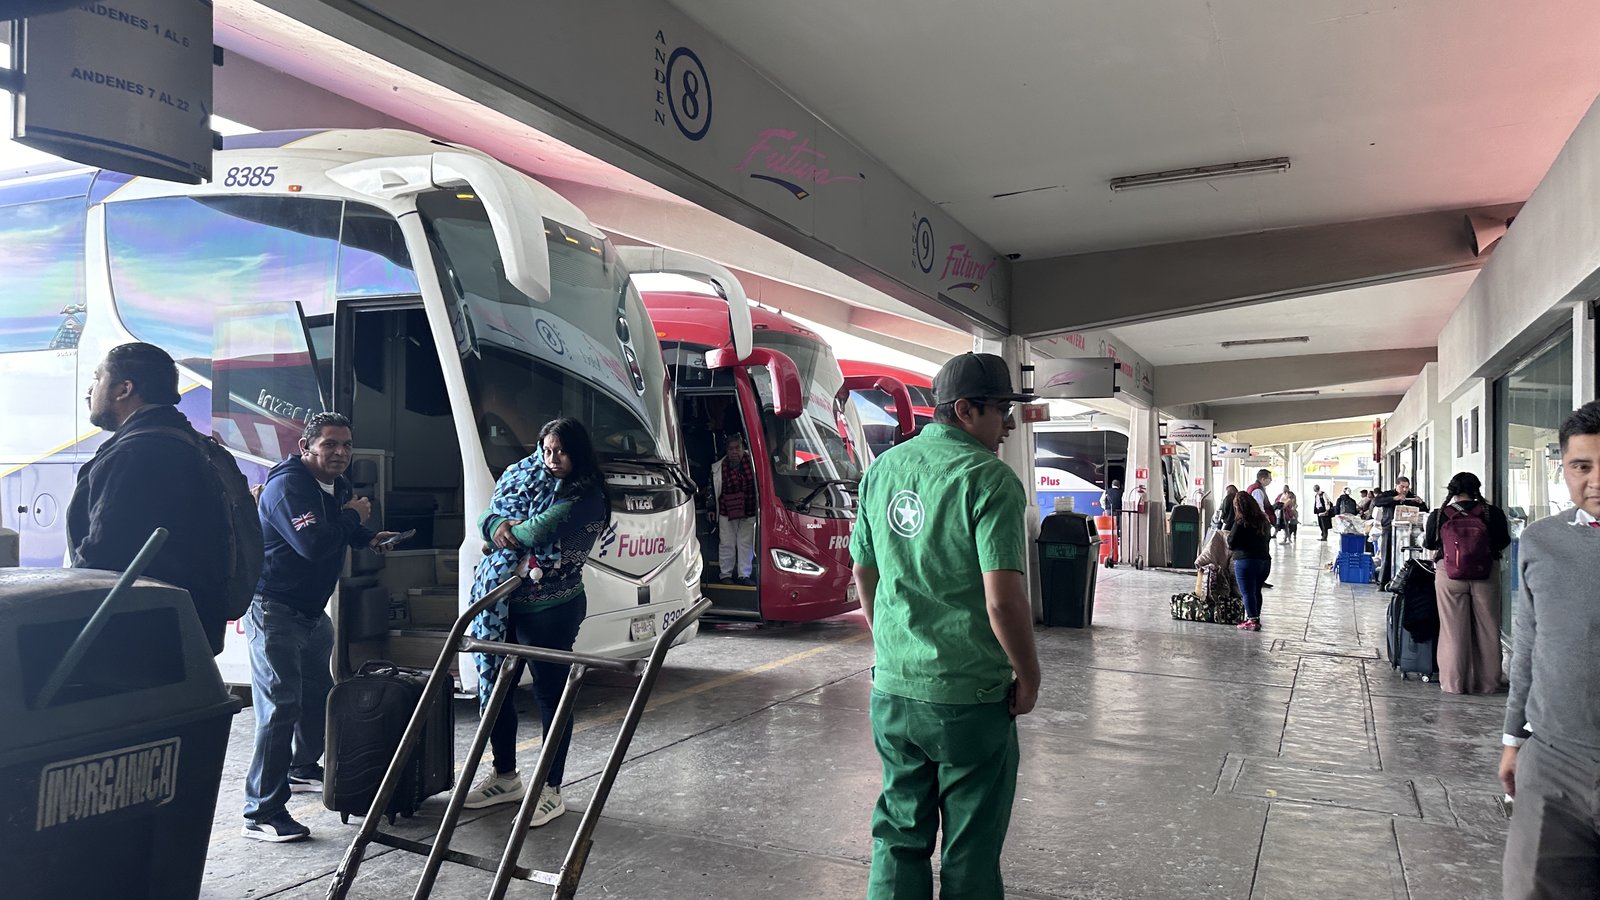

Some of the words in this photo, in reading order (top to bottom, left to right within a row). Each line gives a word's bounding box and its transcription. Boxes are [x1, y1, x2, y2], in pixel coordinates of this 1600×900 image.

[79, 3, 149, 30] NDENES
[153, 24, 160, 35] 1
[164, 29, 180, 44] AL
[71, 66, 144, 96] ANDENES
[148, 87, 156, 99] 7
[159, 91, 176, 107] AL
[177, 98, 190, 112] 22
[224, 166, 278, 187] 8385
[1040, 476, 1061, 486] Plus
[617, 534, 666, 558] Futura
[829, 535, 850, 550] FRO
